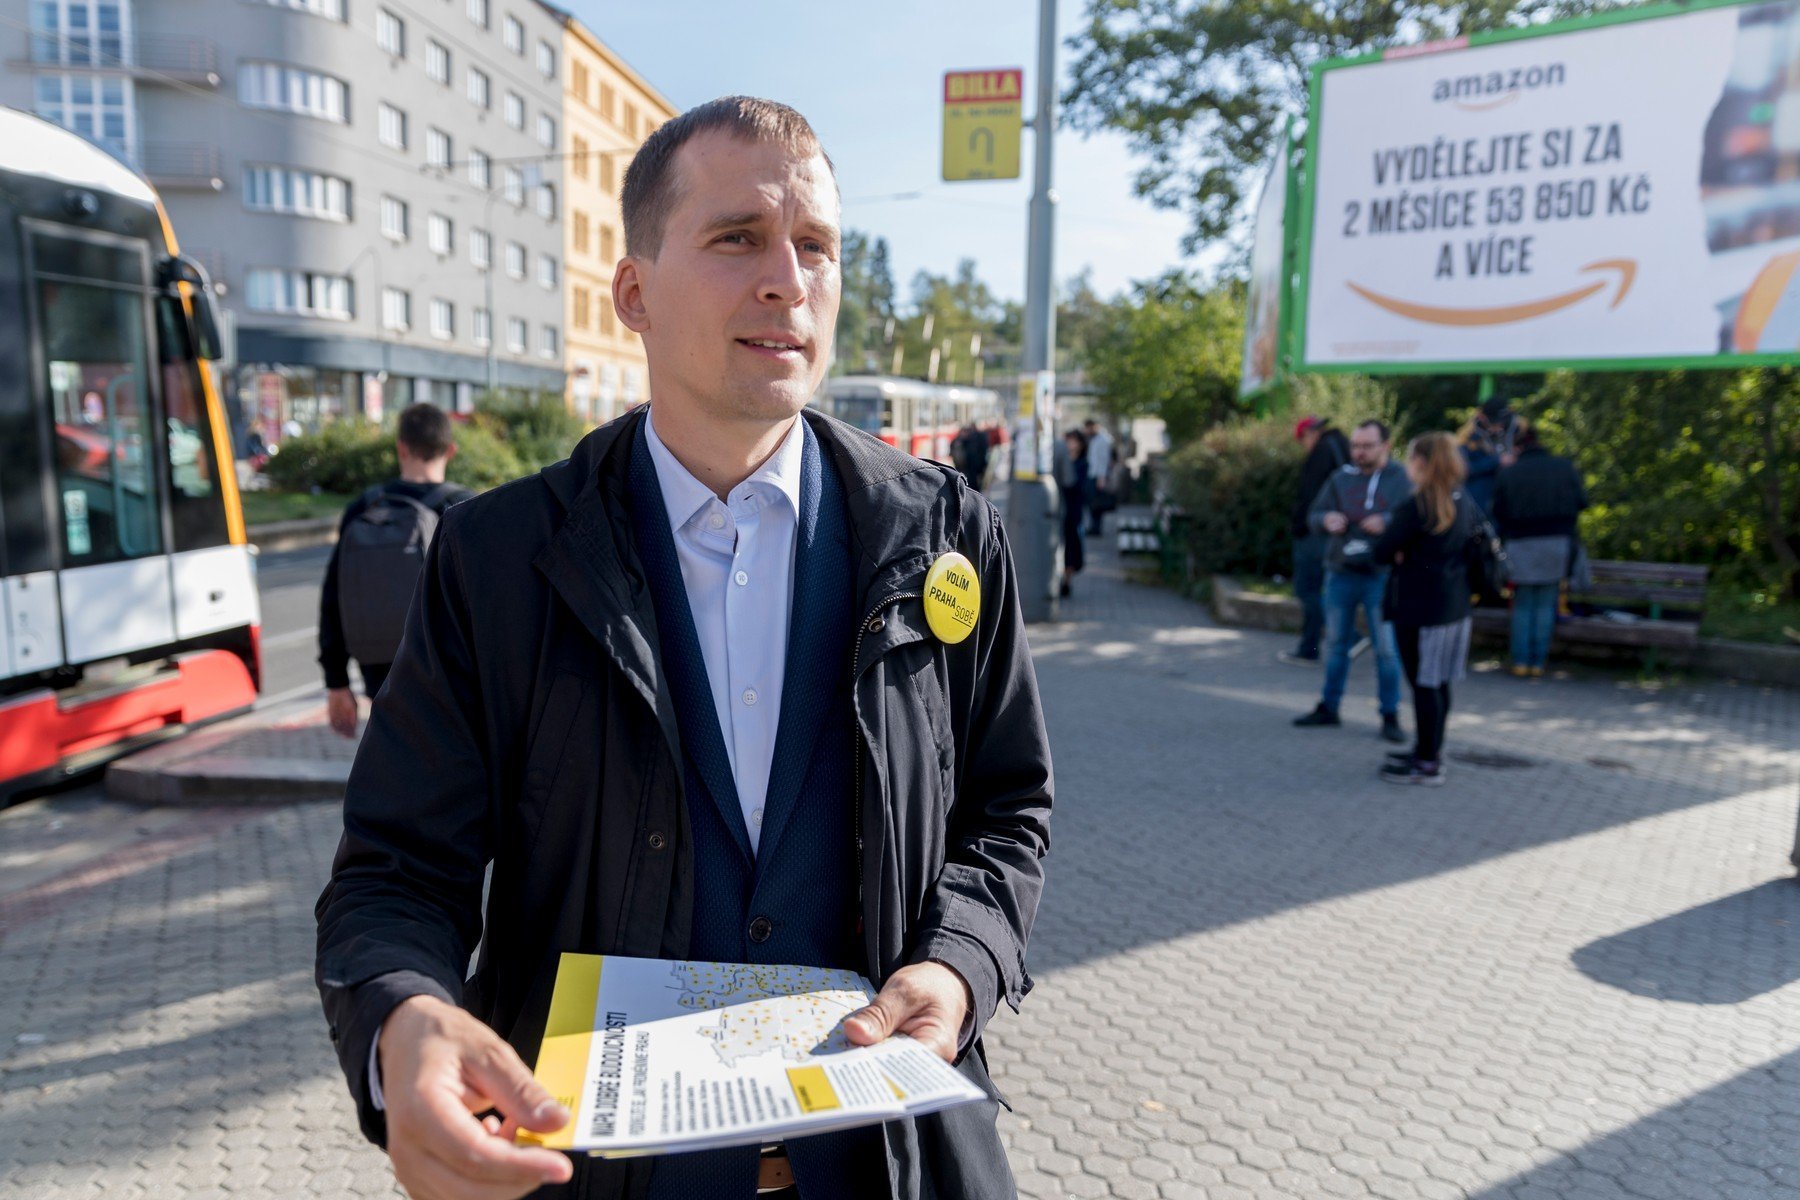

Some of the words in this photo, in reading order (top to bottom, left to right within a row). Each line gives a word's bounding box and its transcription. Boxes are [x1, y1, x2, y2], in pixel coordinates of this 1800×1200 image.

[948, 73, 1018, 99] BILLA
[1433, 62, 1566, 102] amazon
[1373, 132, 1533, 185] VYDĚLEJTE
[1541, 127, 1573, 169] SI
[1582, 121, 1623, 164] ZA
[1342, 199, 1361, 238] 2
[1368, 185, 1479, 236] MĚSÍCE
[1486, 185, 1525, 226] 53
[1533, 178, 1597, 222] 850
[1606, 173, 1653, 215] KČ
[1435, 240, 1455, 279] A
[1465, 233, 1535, 278] VÍCE
[946, 569, 970, 592] VOLÍM
[929, 586, 956, 609] PRAHA
[954, 605, 975, 625] SOBĚ
[600, 1011, 627, 1078] BUDOUCNOSTI
[593, 1080, 620, 1109] DOBRÉ
